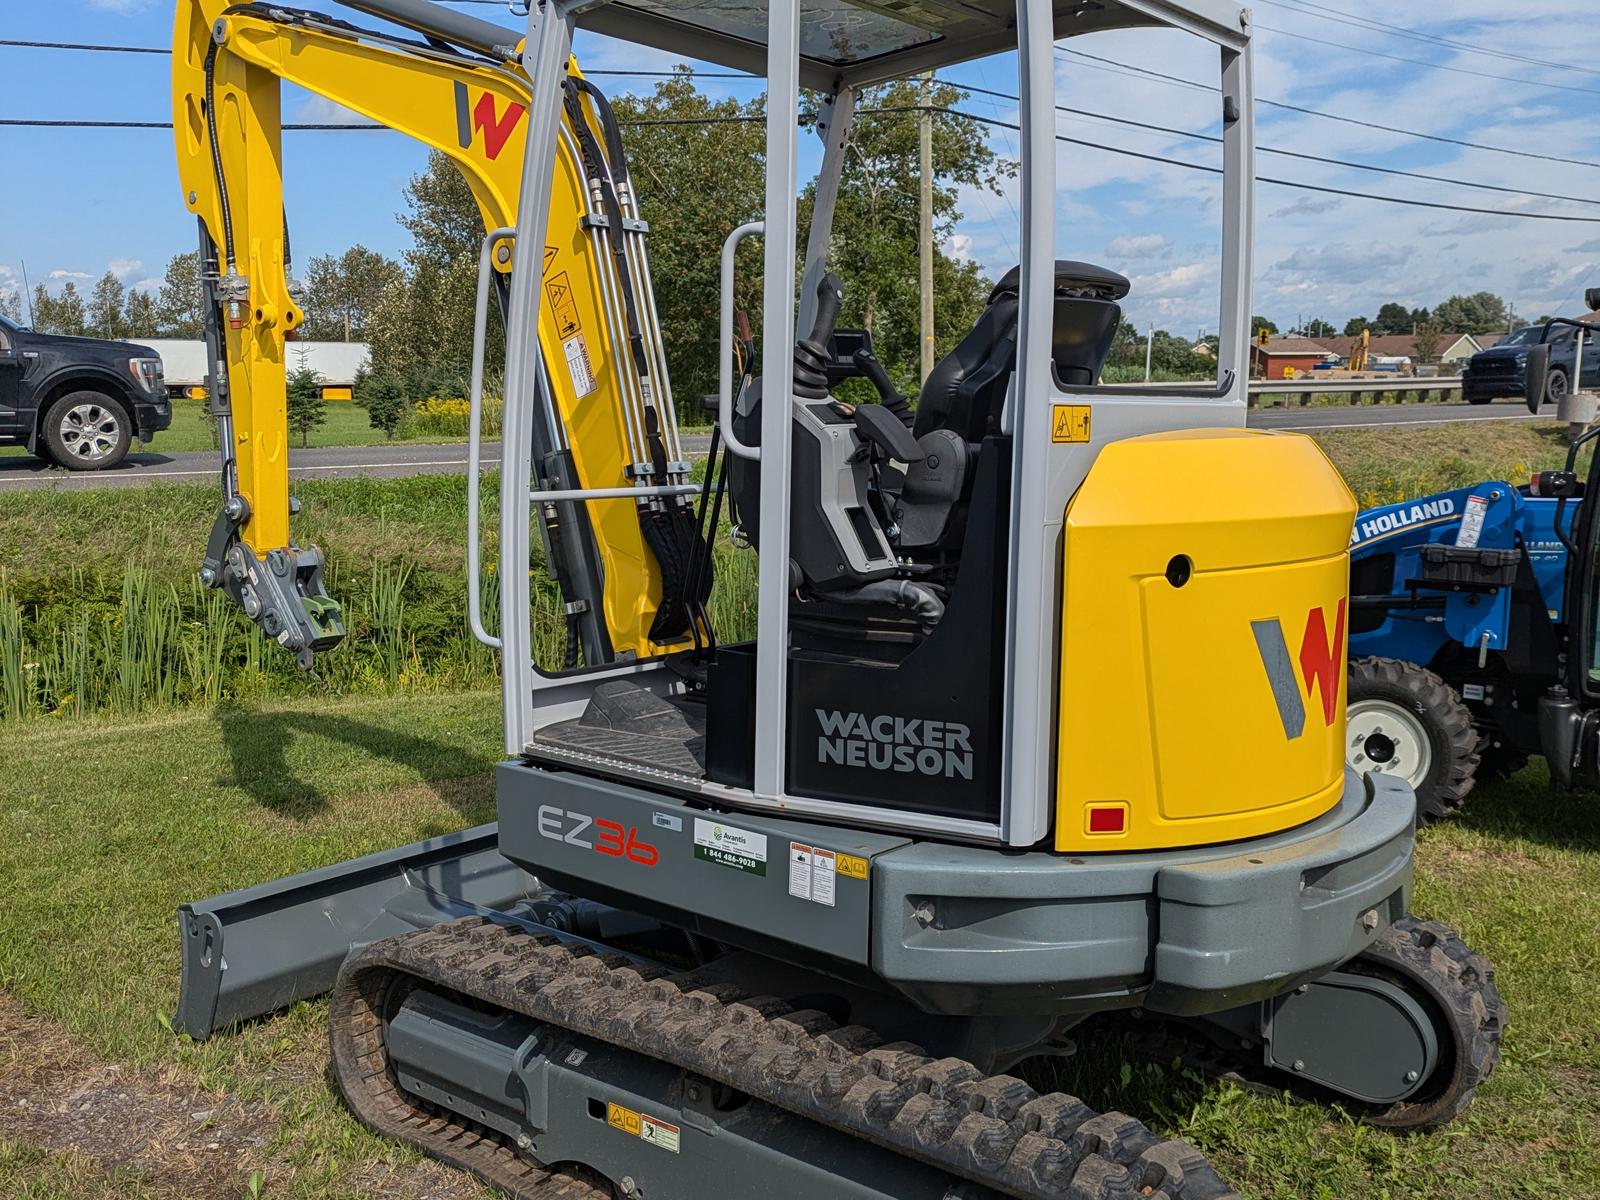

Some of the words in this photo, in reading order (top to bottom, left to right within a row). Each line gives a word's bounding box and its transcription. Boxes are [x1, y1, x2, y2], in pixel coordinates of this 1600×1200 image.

[581, 347, 596, 383] WARNING
[1362, 499, 1454, 538] HOLLAND
[815, 708, 973, 751] WACKER
[818, 736, 973, 780] NEUSON
[538, 804, 659, 868] EZ36
[723, 832, 746, 844] Avantis
[709, 849, 722, 858] 844
[723, 853, 756, 868] 486-9028
